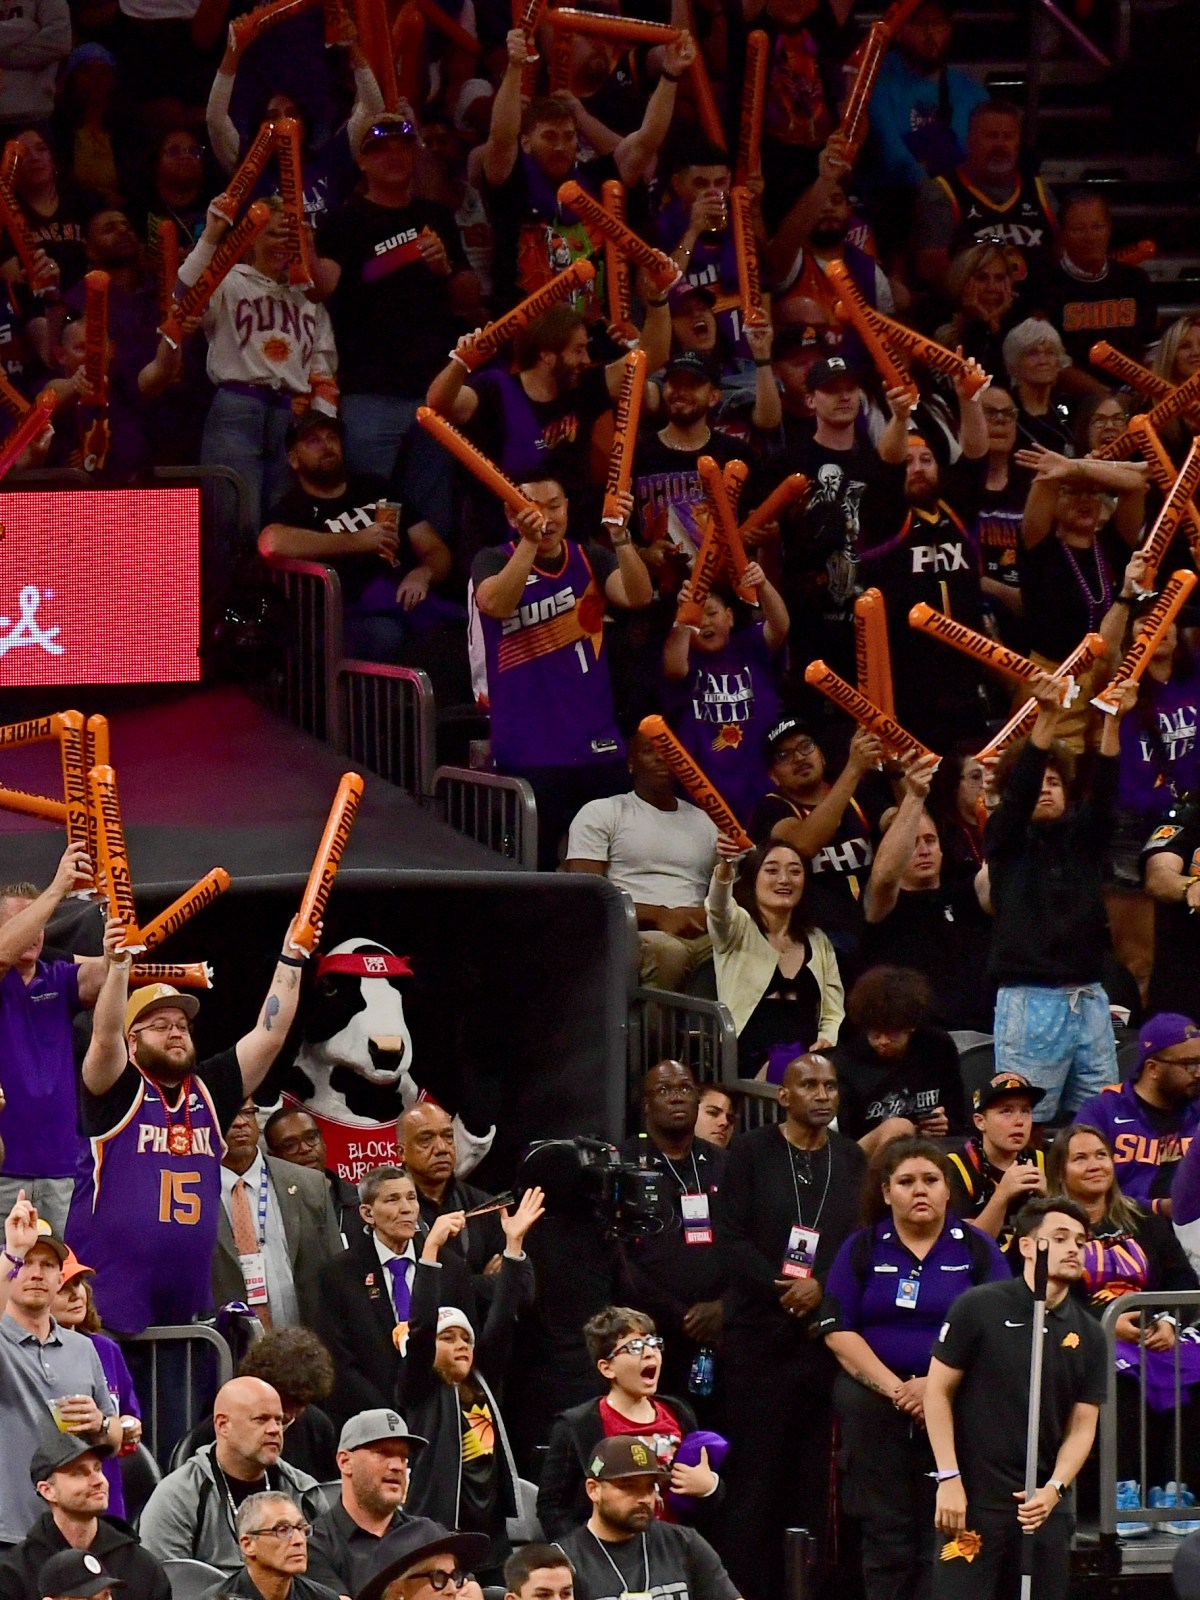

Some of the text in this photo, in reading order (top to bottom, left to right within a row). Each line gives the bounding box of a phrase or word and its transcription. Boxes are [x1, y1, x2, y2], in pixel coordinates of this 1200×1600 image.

[278, 134, 302, 266] PHOENIX SUNS
[374, 228, 418, 256] SUNS
[573, 196, 666, 273] PHOENIX SUNS
[175, 215, 256, 320] PHOENIX SUNS
[236, 297, 316, 369] SUNS
[476, 269, 578, 354] PHOENIX SUNS
[1063, 299, 1137, 331] SUNS
[1100, 353, 1171, 395] PHOENIX
[1150, 375, 1200, 428] HOENIX
[604, 362, 634, 496] PHOENIX SUNS
[636, 471, 700, 504] PHOE
[1136, 431, 1168, 492] PHOENI
[910, 543, 969, 573] PHX
[1145, 515, 1176, 568] SUNS
[502, 586, 577, 636] SUNS
[924, 613, 1003, 658] PHOENIX
[1140, 578, 1183, 641] PHOENIX
[576, 641, 589, 674] 1
[818, 673, 882, 723] PHOENIX
[64, 727, 85, 803] PHOENIX
[651, 733, 740, 840] PHOENIX SUNS
[98, 781, 137, 925] PHOENIX SUNS
[310, 790, 359, 930] PHOENIX SUNS
[160, 879, 221, 937] PHOENIX
[134, 964, 187, 979] SUNS
[347, 1141, 398, 1161] BLOCK
[1114, 1133, 1193, 1167] SU
[158, 1169, 202, 1225] 15
